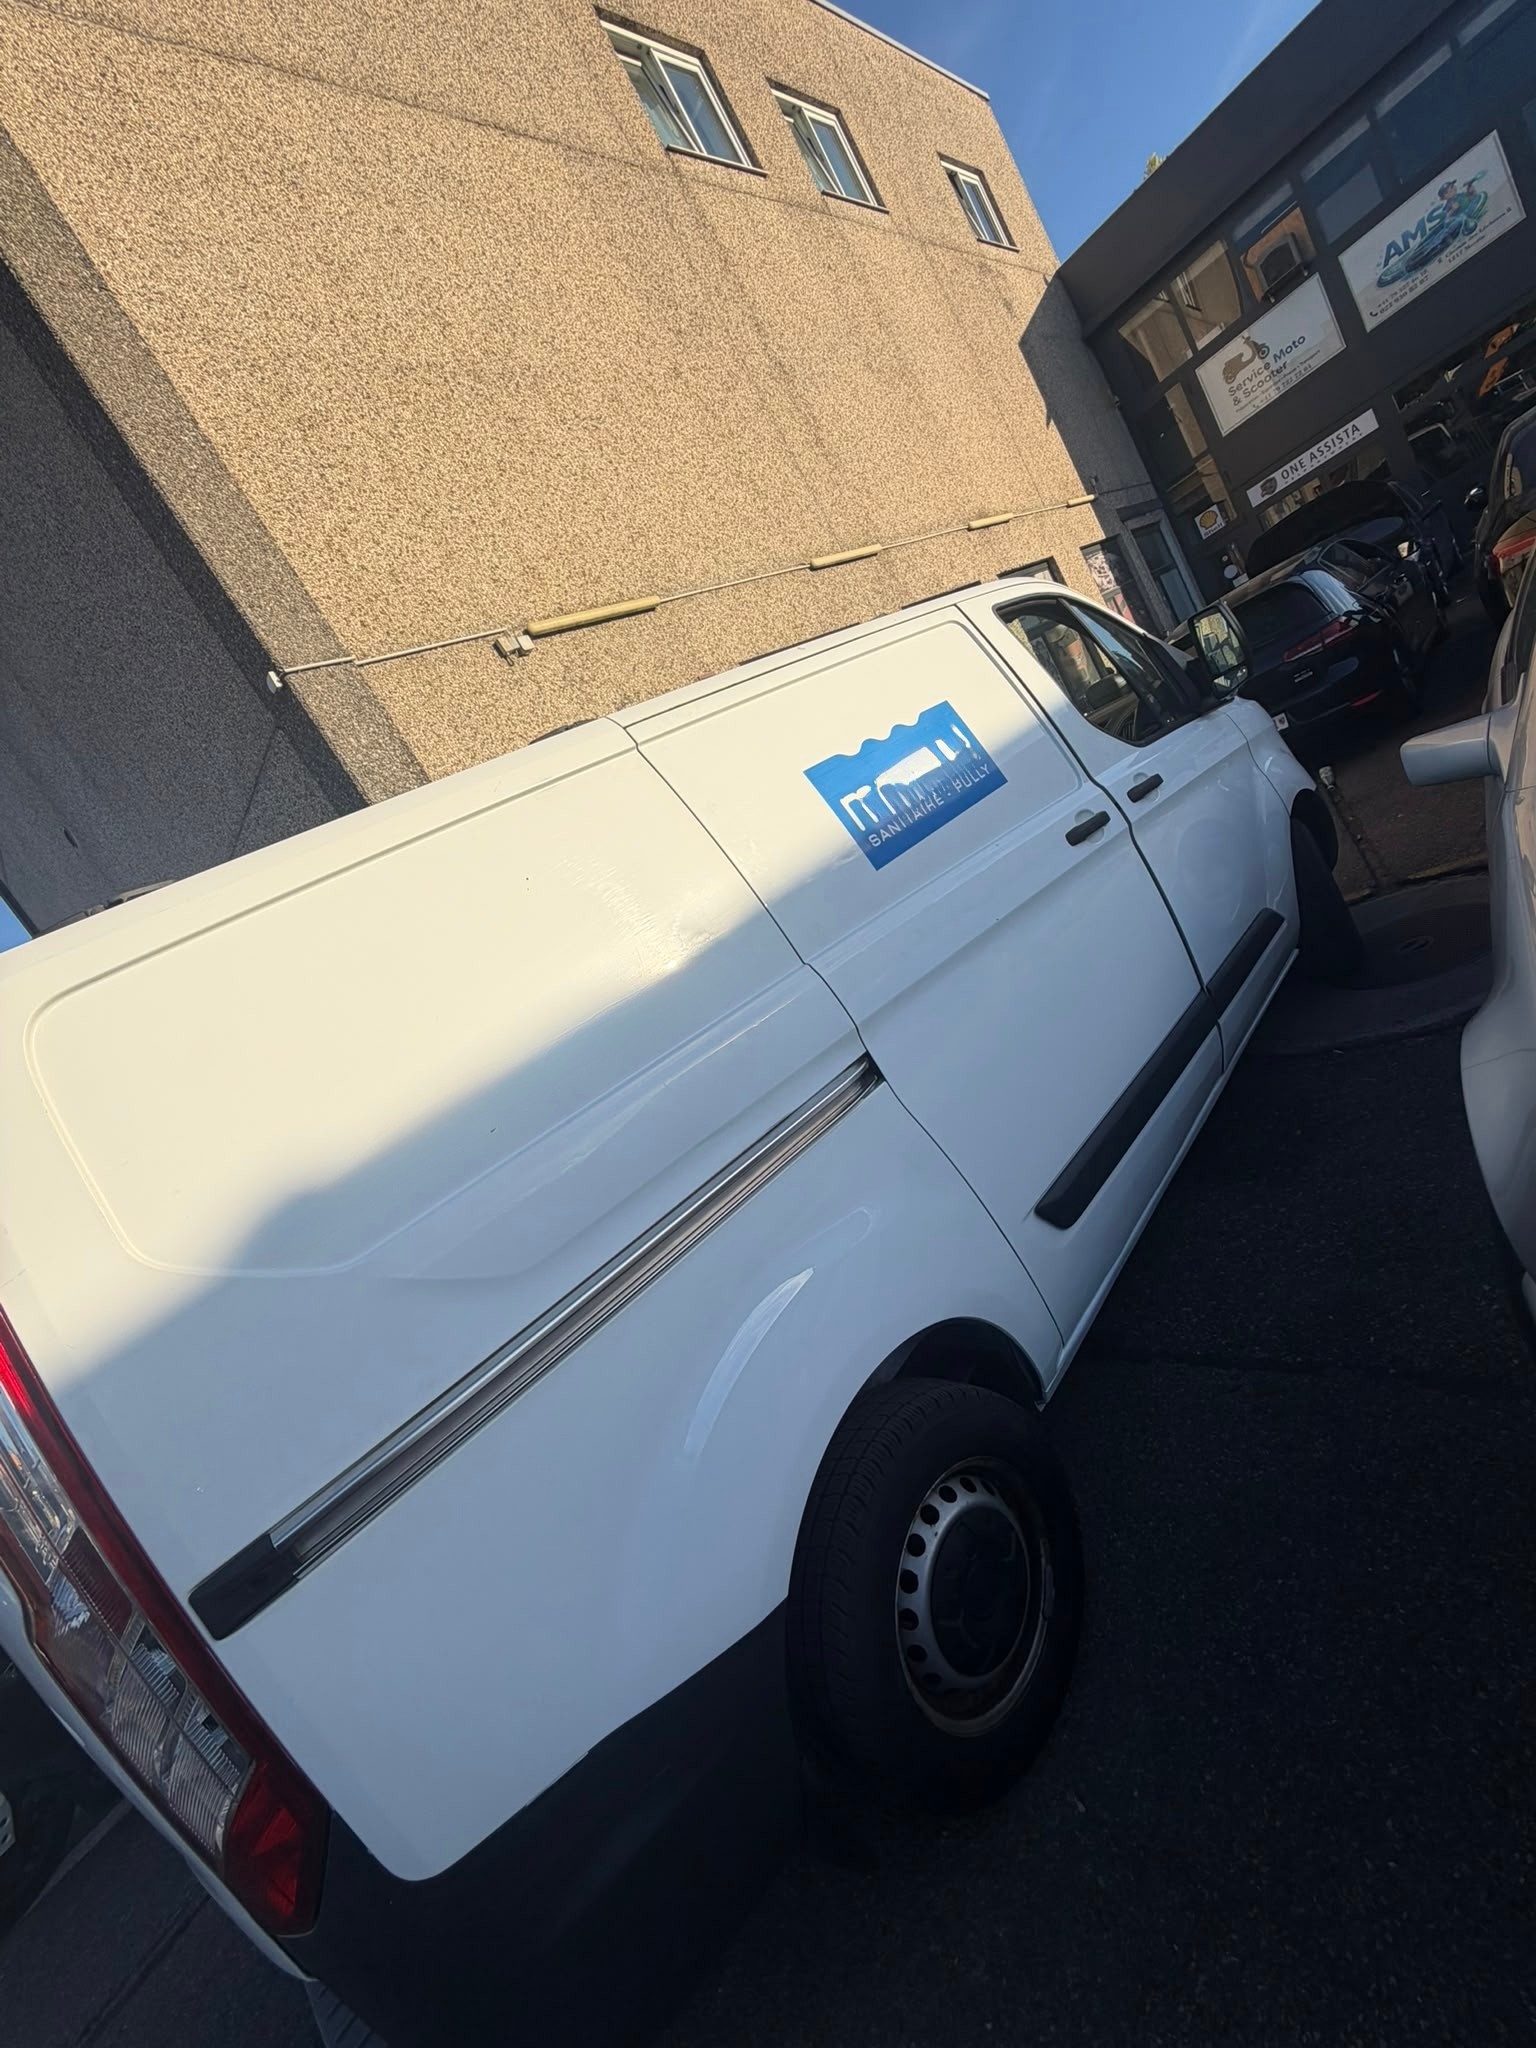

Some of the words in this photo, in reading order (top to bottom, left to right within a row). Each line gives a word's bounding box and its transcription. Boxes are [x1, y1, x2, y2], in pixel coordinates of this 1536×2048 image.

[1383, 203, 1446, 269] AMS
[1228, 361, 1271, 397] Service
[1273, 335, 1306, 363] Moto
[1232, 396, 1241, 406] &
[1242, 360, 1288, 398] Scooter
[1281, 457, 1306, 480] ONE
[1309, 423, 1360, 463] ASSISTA
[951, 763, 990, 793] PULLY
